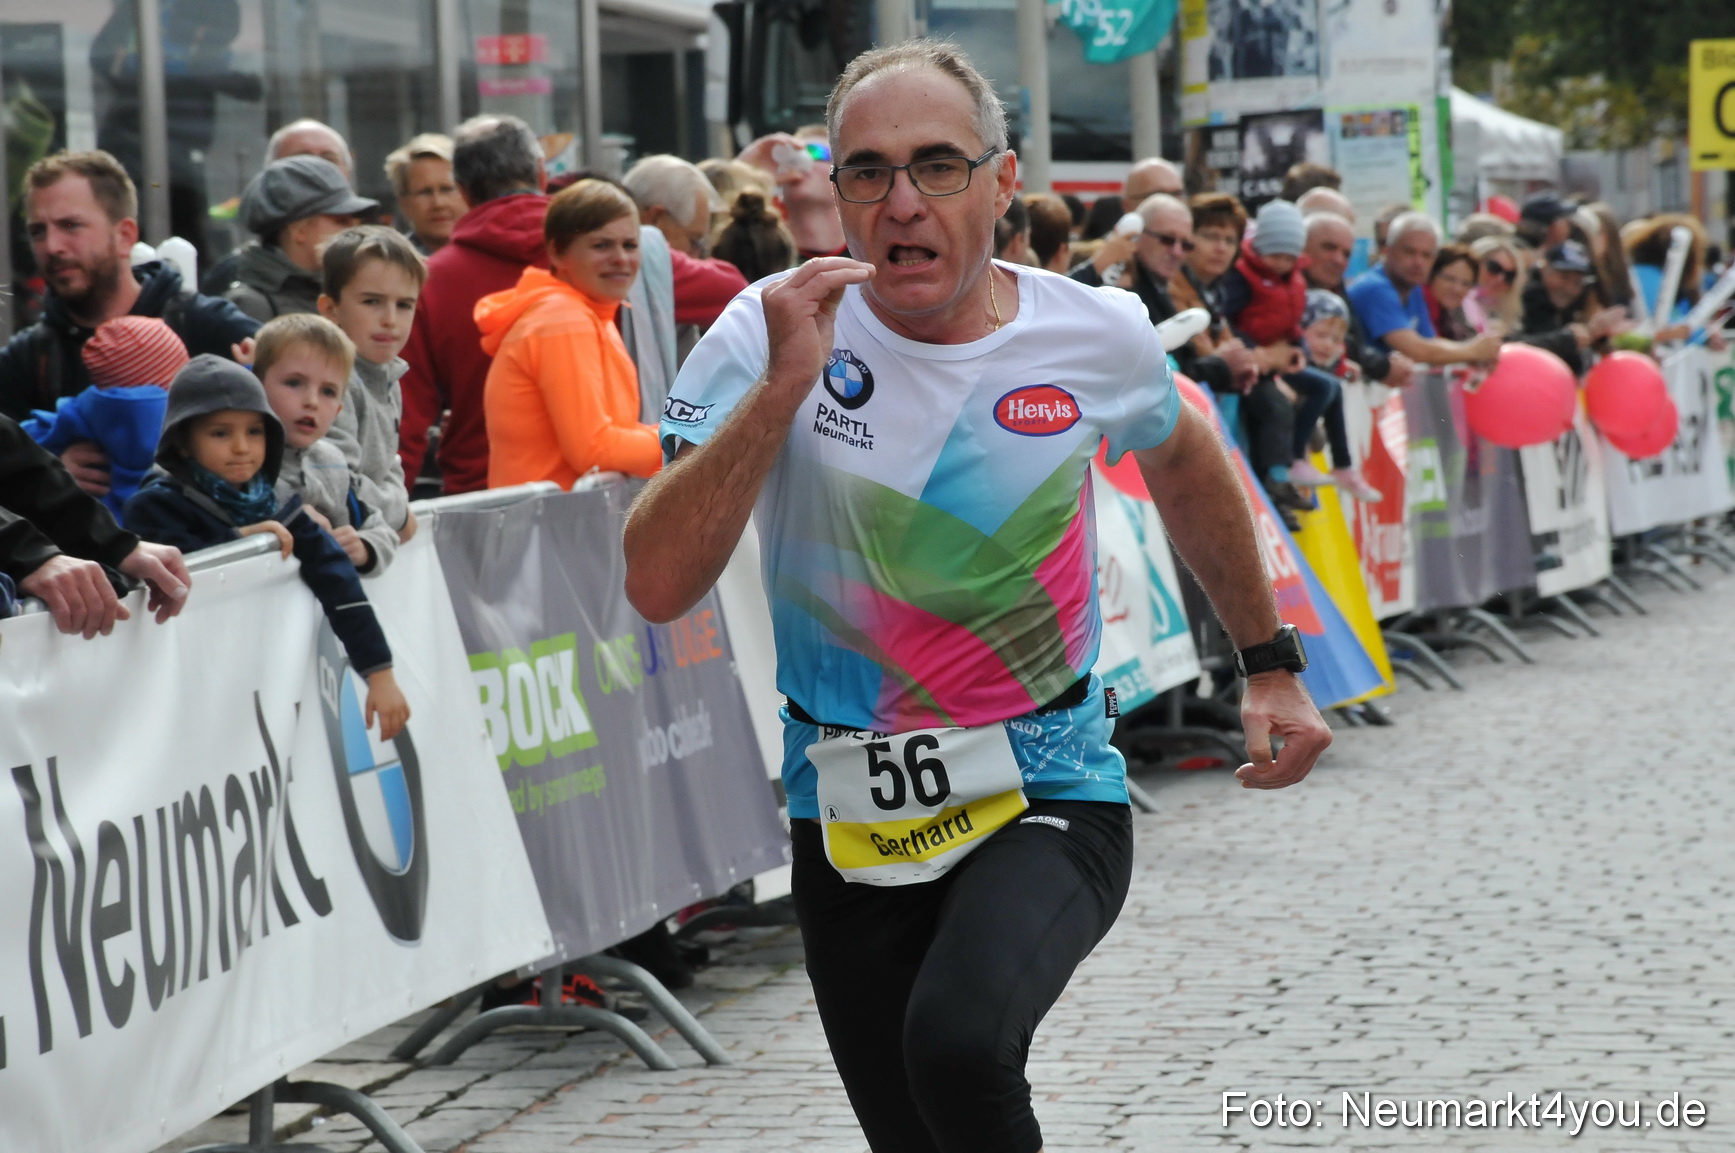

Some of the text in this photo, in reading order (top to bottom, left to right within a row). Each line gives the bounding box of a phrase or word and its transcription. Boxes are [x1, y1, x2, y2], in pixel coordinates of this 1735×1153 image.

[815, 402, 874, 438] PARTL
[1008, 399, 1073, 422] Hervis
[813, 420, 874, 450] Neumarkt
[862, 733, 952, 812] 56
[870, 808, 975, 857] Gerhard
[10, 690, 333, 1056] Neumarkt
